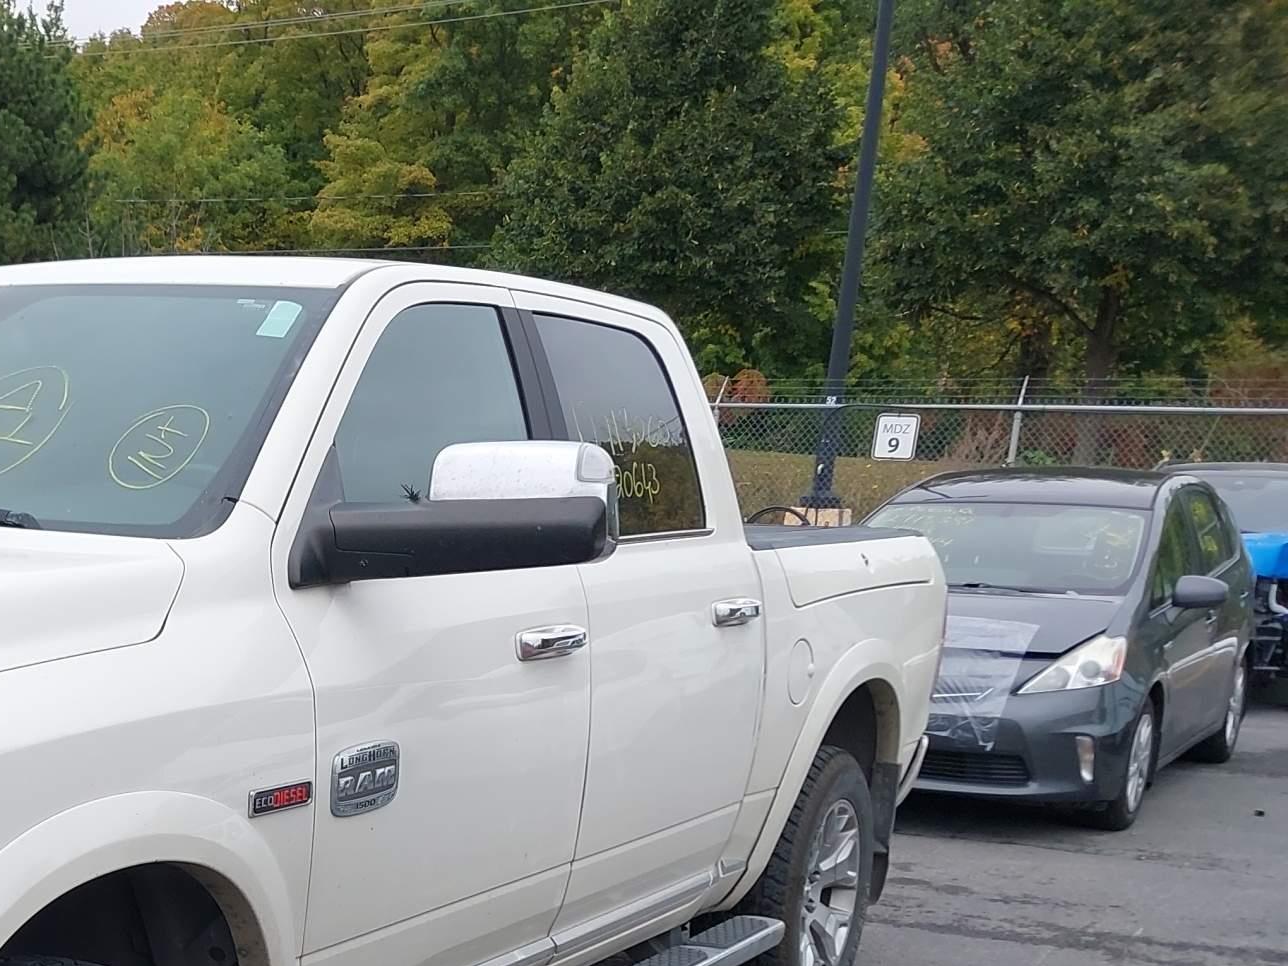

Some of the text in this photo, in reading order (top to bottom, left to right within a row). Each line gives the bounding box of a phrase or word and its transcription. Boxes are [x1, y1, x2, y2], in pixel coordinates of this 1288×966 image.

[882, 423, 911, 435] MDZ
[887, 437, 900, 453] 9
[338, 764, 395, 797] RAM
[356, 798, 376, 809] 1500
